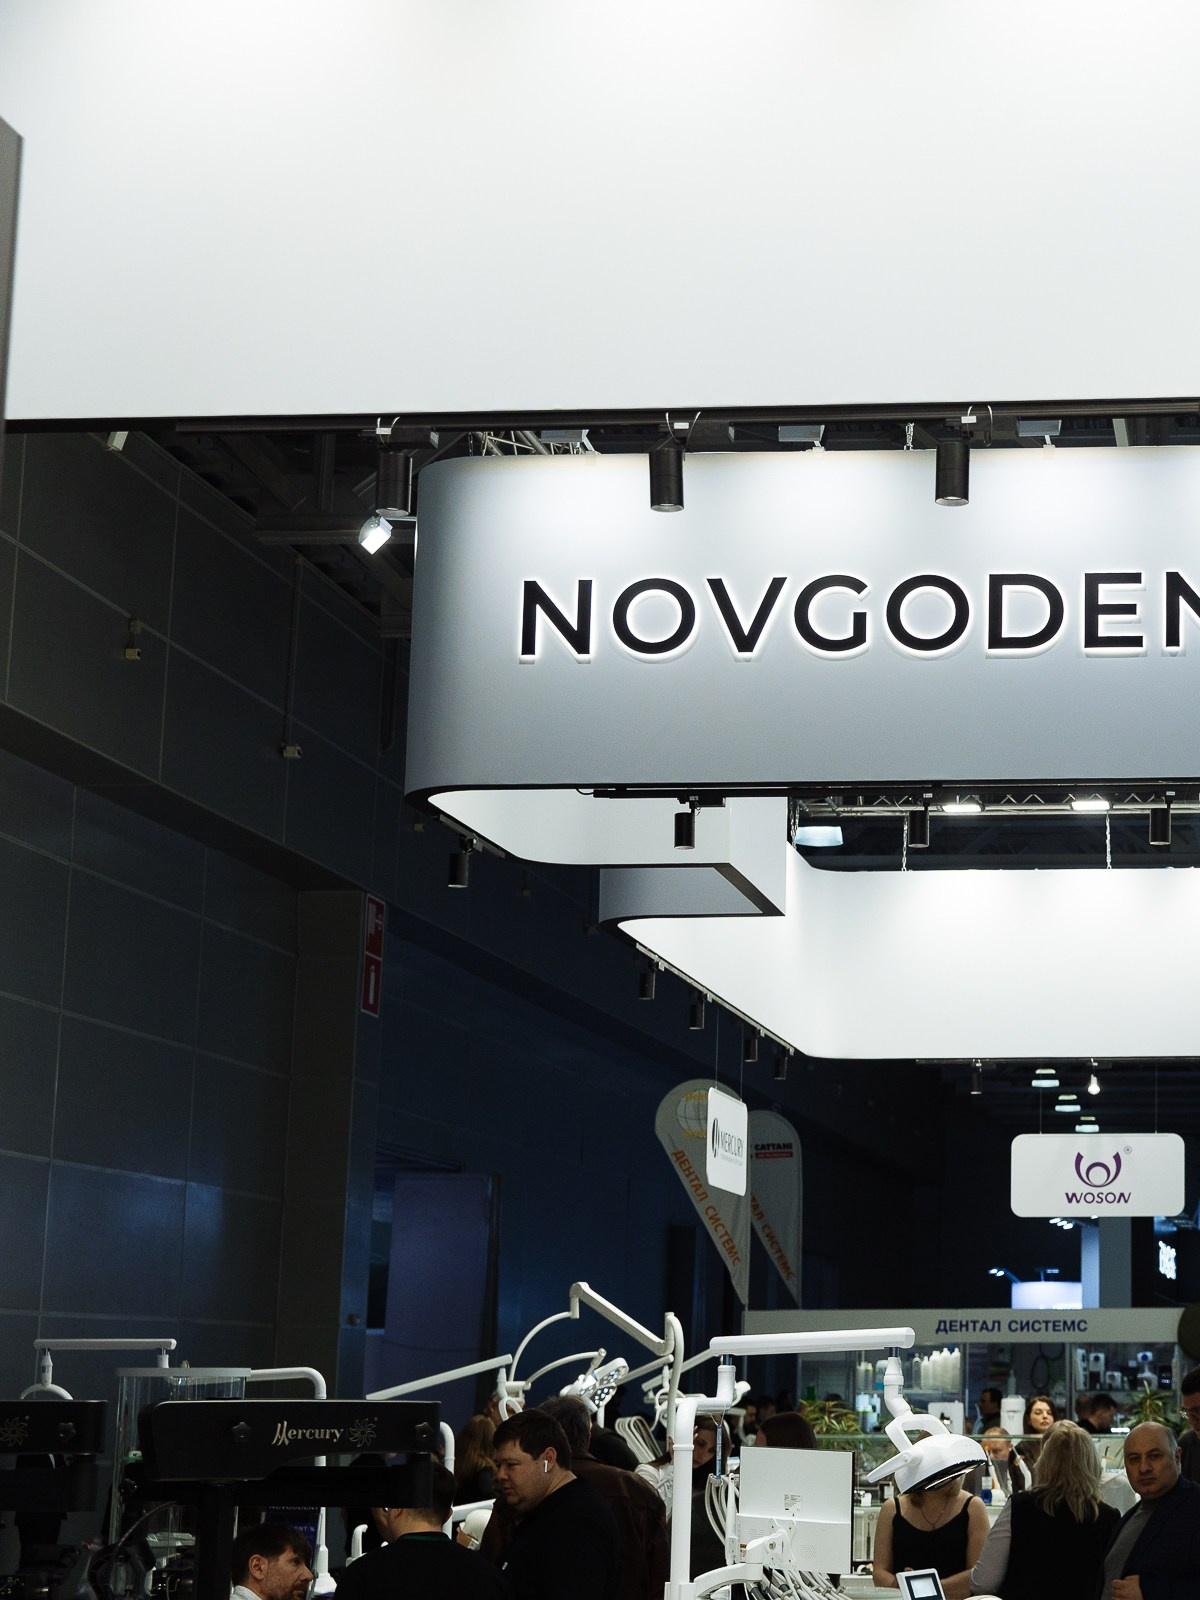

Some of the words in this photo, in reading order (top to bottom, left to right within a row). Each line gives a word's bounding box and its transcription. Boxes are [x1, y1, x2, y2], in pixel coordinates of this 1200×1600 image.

[754, 1142, 793, 1151] CATTANI
[1065, 1192, 1131, 1204] WOSON
[673, 1150, 708, 1203] ДЕНТАЛ
[704, 1205, 742, 1267] СИСТЕМС
[935, 1319, 1001, 1335] ДЕНТАЛ
[1008, 1319, 1088, 1333] СИСТЕМС
[272, 1420, 344, 1446] Mercury
